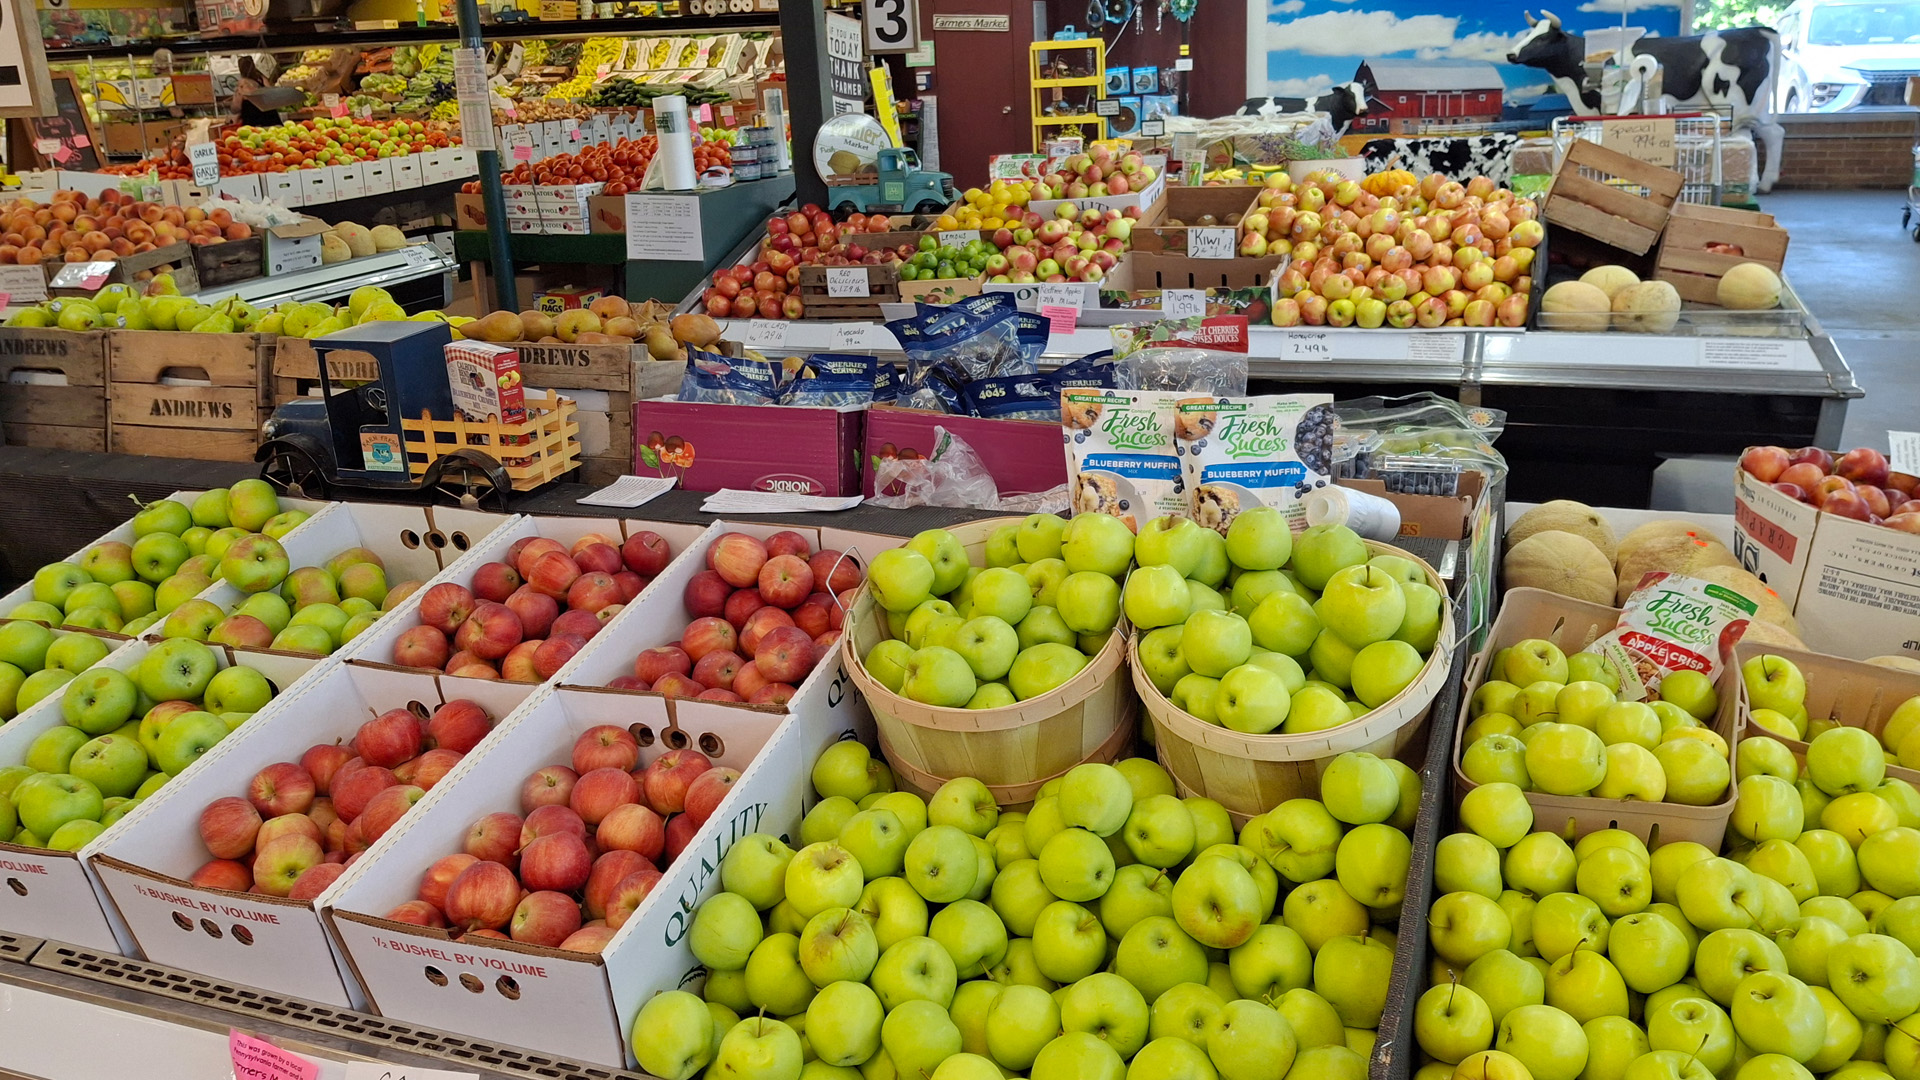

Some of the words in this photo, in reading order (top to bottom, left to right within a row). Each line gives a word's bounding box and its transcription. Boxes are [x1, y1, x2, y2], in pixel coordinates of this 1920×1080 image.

[874, 0, 908, 43] 3
[935, 17, 971, 29] Farmers
[973, 18, 1007, 29] Market
[836, 28, 848, 40] YOU
[850, 32, 860, 42] ATE
[830, 37, 859, 59] TODAY
[829, 56, 860, 80] THANK
[836, 82, 862, 97] FARMER
[1610, 121, 1656, 139] Special
[843, 138, 869, 151] Market
[193, 147, 215, 159] GARLIC
[195, 165, 218, 178] GARLIC
[1167, 290, 1194, 301] Plums
[541, 304, 563, 313] RAGS
[966, 295, 1005, 310] CHERRIES
[973, 299, 1002, 315] CERISES
[752, 321, 768, 329] PINK
[770, 322, 788, 331] LADY
[837, 327, 865, 336] Avocado
[1207, 325, 1239, 335] CHERRIES
[1213, 334, 1239, 343] DOUCES
[1288, 332, 1326, 340] Honeycrisp
[734, 365, 772, 375] CHERRIES
[826, 360, 867, 369] CHERRIES
[831, 367, 864, 375] CERISES
[1060, 379, 1103, 387] CHERRIES
[452, 387, 478, 400] BLUEBERRY
[478, 395, 499, 408] CRUMBLE
[978, 388, 1007, 400] 4045
[1107, 397, 1128, 405] RECIPE
[149, 398, 233, 419] ANDREWS
[1101, 408, 1163, 433] Fresh
[1218, 413, 1284, 441] Fresh
[1107, 425, 1168, 446] Success
[1224, 431, 1288, 455] Success
[1089, 459, 1142, 469] BLUEBERRY
[1143, 461, 1178, 470] MUFFIN
[1207, 469, 1262, 479] BLUEBERRY
[1264, 467, 1301, 477] MUFFIN
[766, 479, 810, 492] NORDIC
[1885, 552, 1917, 564] PRODUCE
[1894, 591, 1920, 601] EGETABLE
[1645, 589, 1718, 627] Fresh
[1645, 608, 1716, 646] Success
[1902, 639, 1920, 651] LIP
[1626, 637, 1666, 658] APPLE
[1669, 650, 1705, 671] CRISP
[1612, 644, 1625, 666] APPLE
[1625, 663, 1637, 683] CRISP
[664, 802, 769, 948] QUALITY
[147, 888, 200, 910] BUSHEL
[199, 901, 218, 914] BY
[219, 905, 281, 925] VOLUME
[389, 940, 452, 962] BUSHEL
[453, 953, 476, 966] BY
[478, 956, 548, 978] VOLUME
[237, 1039, 247, 1049] This
[248, 1045, 261, 1053] was
[261, 1049, 279, 1060] grown
[279, 1056, 286, 1065] by
[289, 1060, 303, 1073] local
[272, 1062, 289, 1075] farmer
